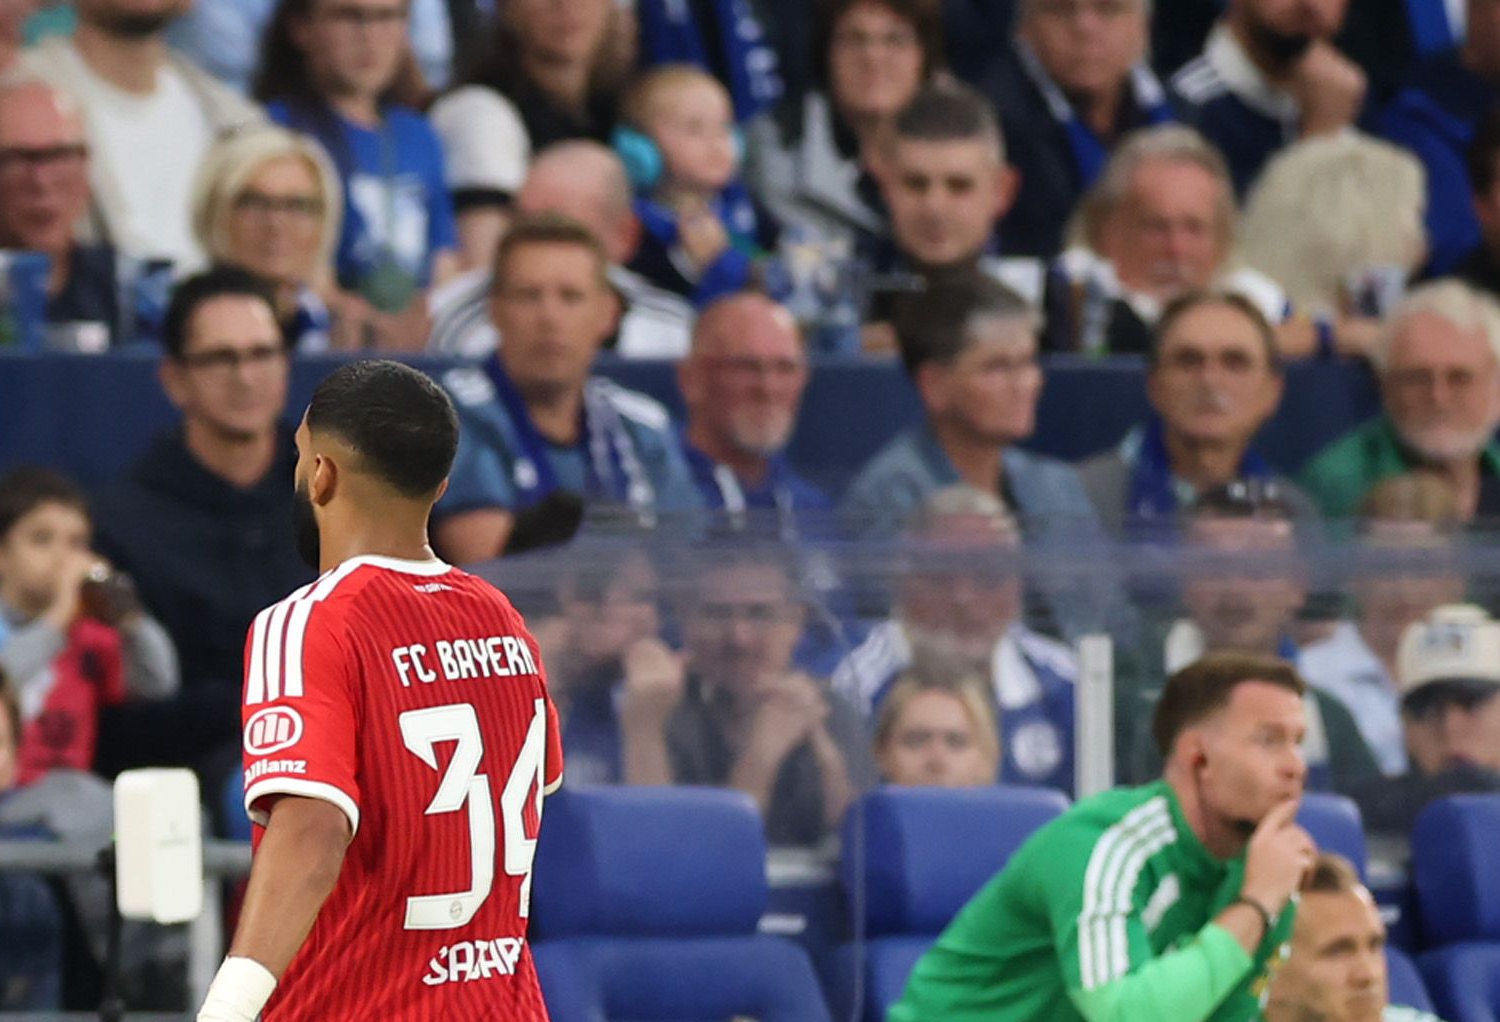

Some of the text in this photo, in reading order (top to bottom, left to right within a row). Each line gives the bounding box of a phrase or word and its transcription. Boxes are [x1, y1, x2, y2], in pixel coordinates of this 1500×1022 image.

[392, 636, 538, 687] FC BAYERN
[399, 698, 547, 930] 34
